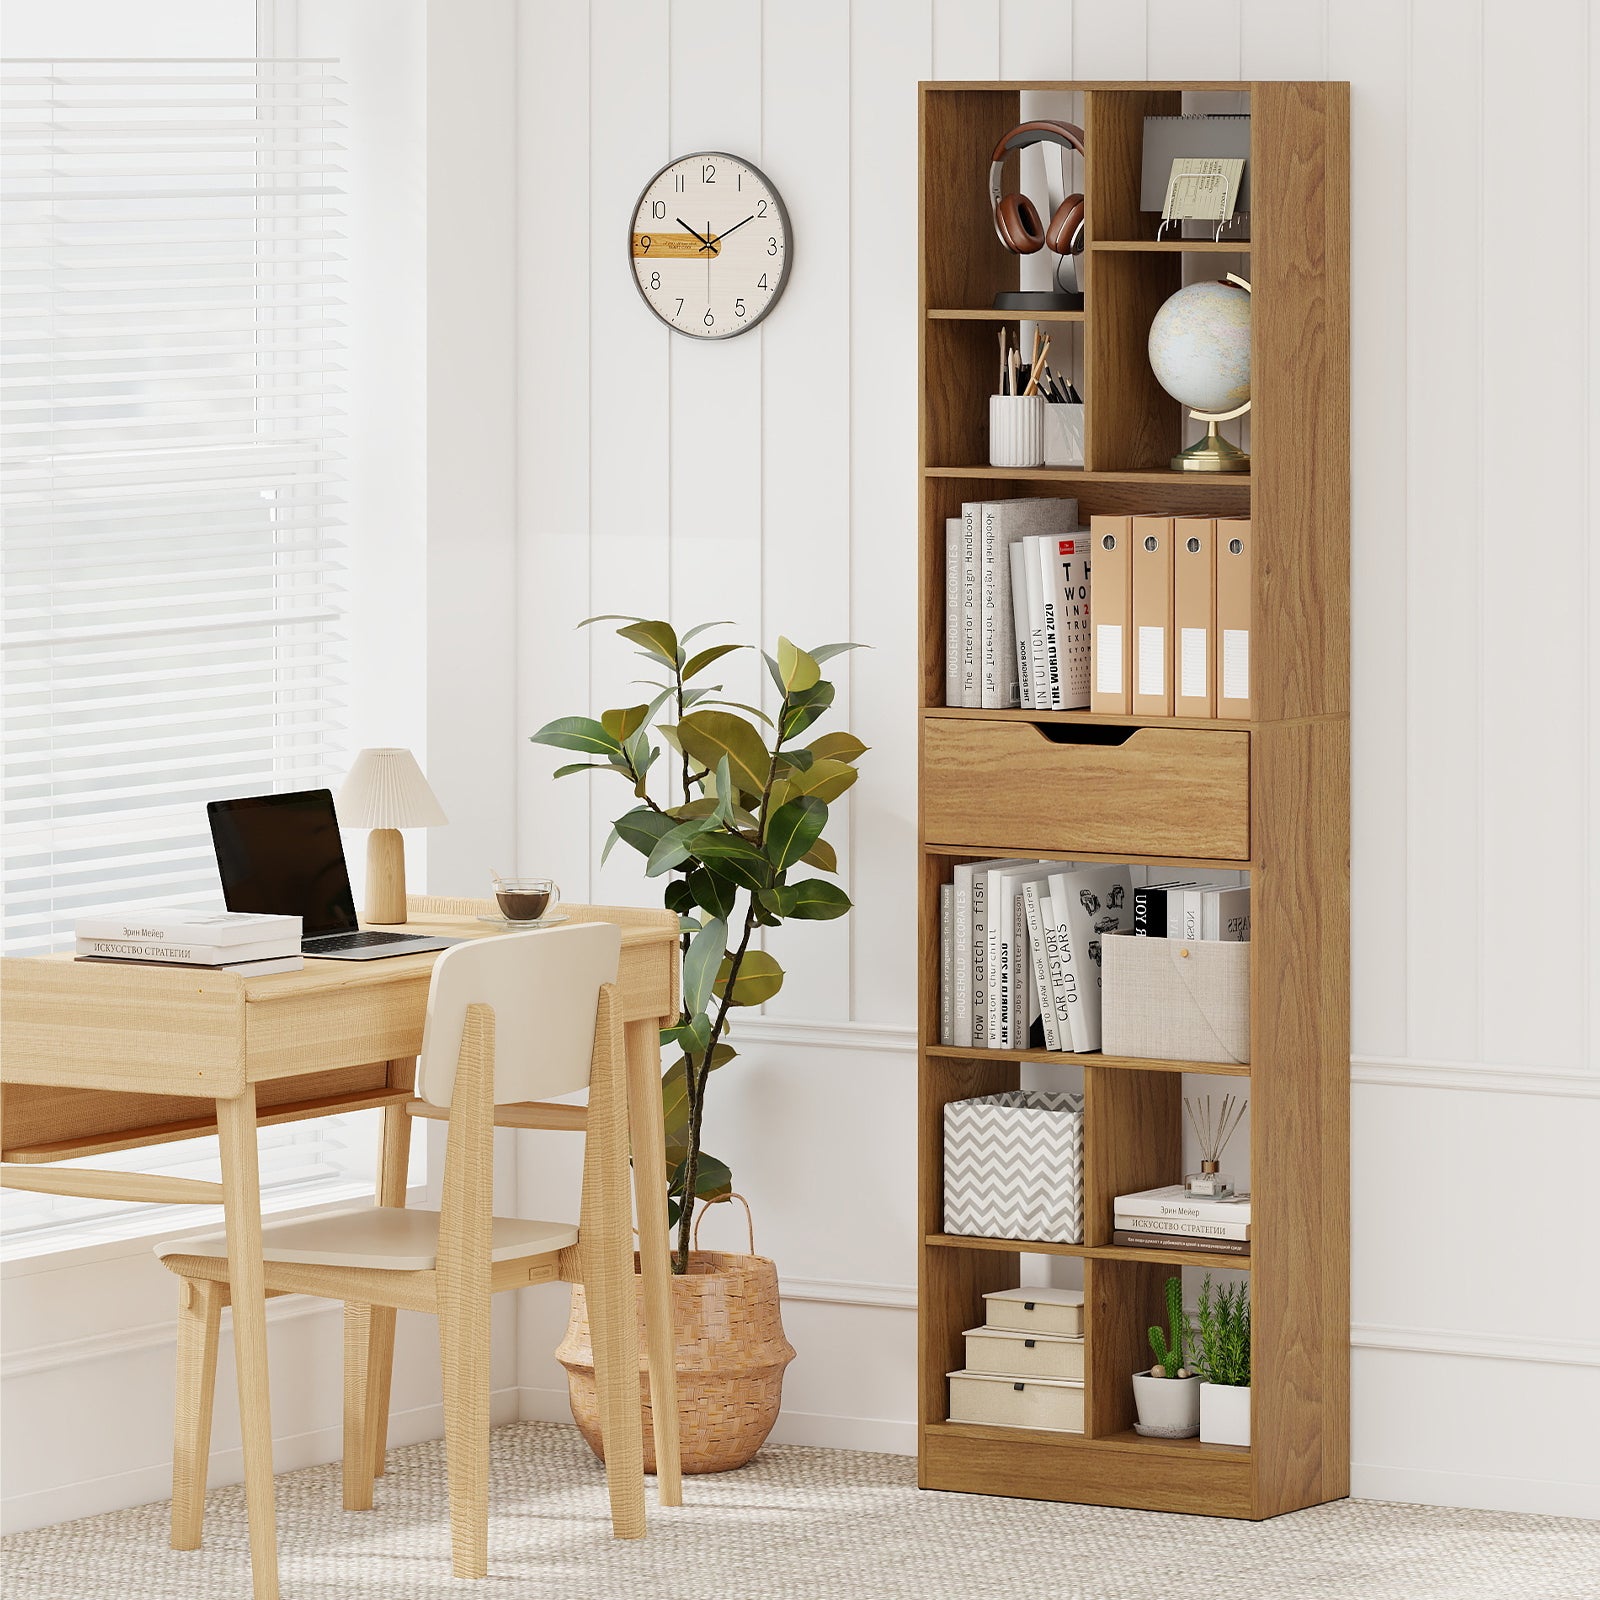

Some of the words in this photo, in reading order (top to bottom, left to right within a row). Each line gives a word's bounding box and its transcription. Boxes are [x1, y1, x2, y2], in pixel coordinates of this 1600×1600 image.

[675, 174, 684, 192] 11
[702, 165, 716, 183] 12
[738, 174, 741, 192] 1
[652, 200, 666, 219] 10
[757, 200, 768, 218] 2
[640, 235, 652, 254] 9
[767, 237, 778, 256] 3
[650, 271, 661, 290] 8
[757, 273, 768, 291] 4
[675, 298, 684, 316] 7
[734, 298, 746, 317] 5
[703, 308, 715, 327] 6
[964, 511, 973, 563] Handbook
[948, 544, 958, 608] DECORATES
[964, 569, 975, 608] Design
[1065, 586, 1091, 600] WO
[1045, 603, 1055, 631] 2020
[1065, 605, 1080, 616] IN
[948, 614, 958, 678] HOUSEHOLD
[964, 614, 973, 665] Interior
[1047, 633, 1055, 644] IN
[1032, 628, 1047, 704] INTUITION
[1048, 646, 1059, 684] WORLD
[964, 671, 973, 691] The
[1052, 686, 1060, 705] THE
[974, 882, 984, 914] fish
[1025, 886, 1038, 931] children
[957, 890, 966, 951] DECORATES
[976, 923, 984, 932] a
[123, 927, 140, 937] Эрин
[141, 928, 164, 939] Мейер
[94, 942, 143, 955] ИСКУССТВО
[145, 946, 191, 959] СТРАТЕГИИ
[1032, 936, 1041, 952] for
[1057, 923, 1071, 963] CARS
[974, 940, 984, 981] catch
[989, 928, 997, 988] Churchill
[1045, 927, 1063, 987] HISTORY
[957, 956, 966, 1019] HOUSEHOLD
[1016, 979, 1023, 989] by
[1064, 973, 1078, 1003] OLD
[974, 990, 984, 1006] to
[1040, 985, 1049, 1008] DRAW
[989, 994, 997, 1040] Winston
[1044, 1012, 1051, 1024] TO
[1056, 995, 1068, 1022] CAR
[974, 1014, 984, 1040] How
[1046, 1029, 1055, 1047] HOW
[1160, 1205, 1176, 1215] Эрин
[1178, 1207, 1200, 1218] Мейер
[1132, 1219, 1179, 1231] ИСКУССТВО
[1181, 1224, 1226, 1235] СТРАТЕГИИ
